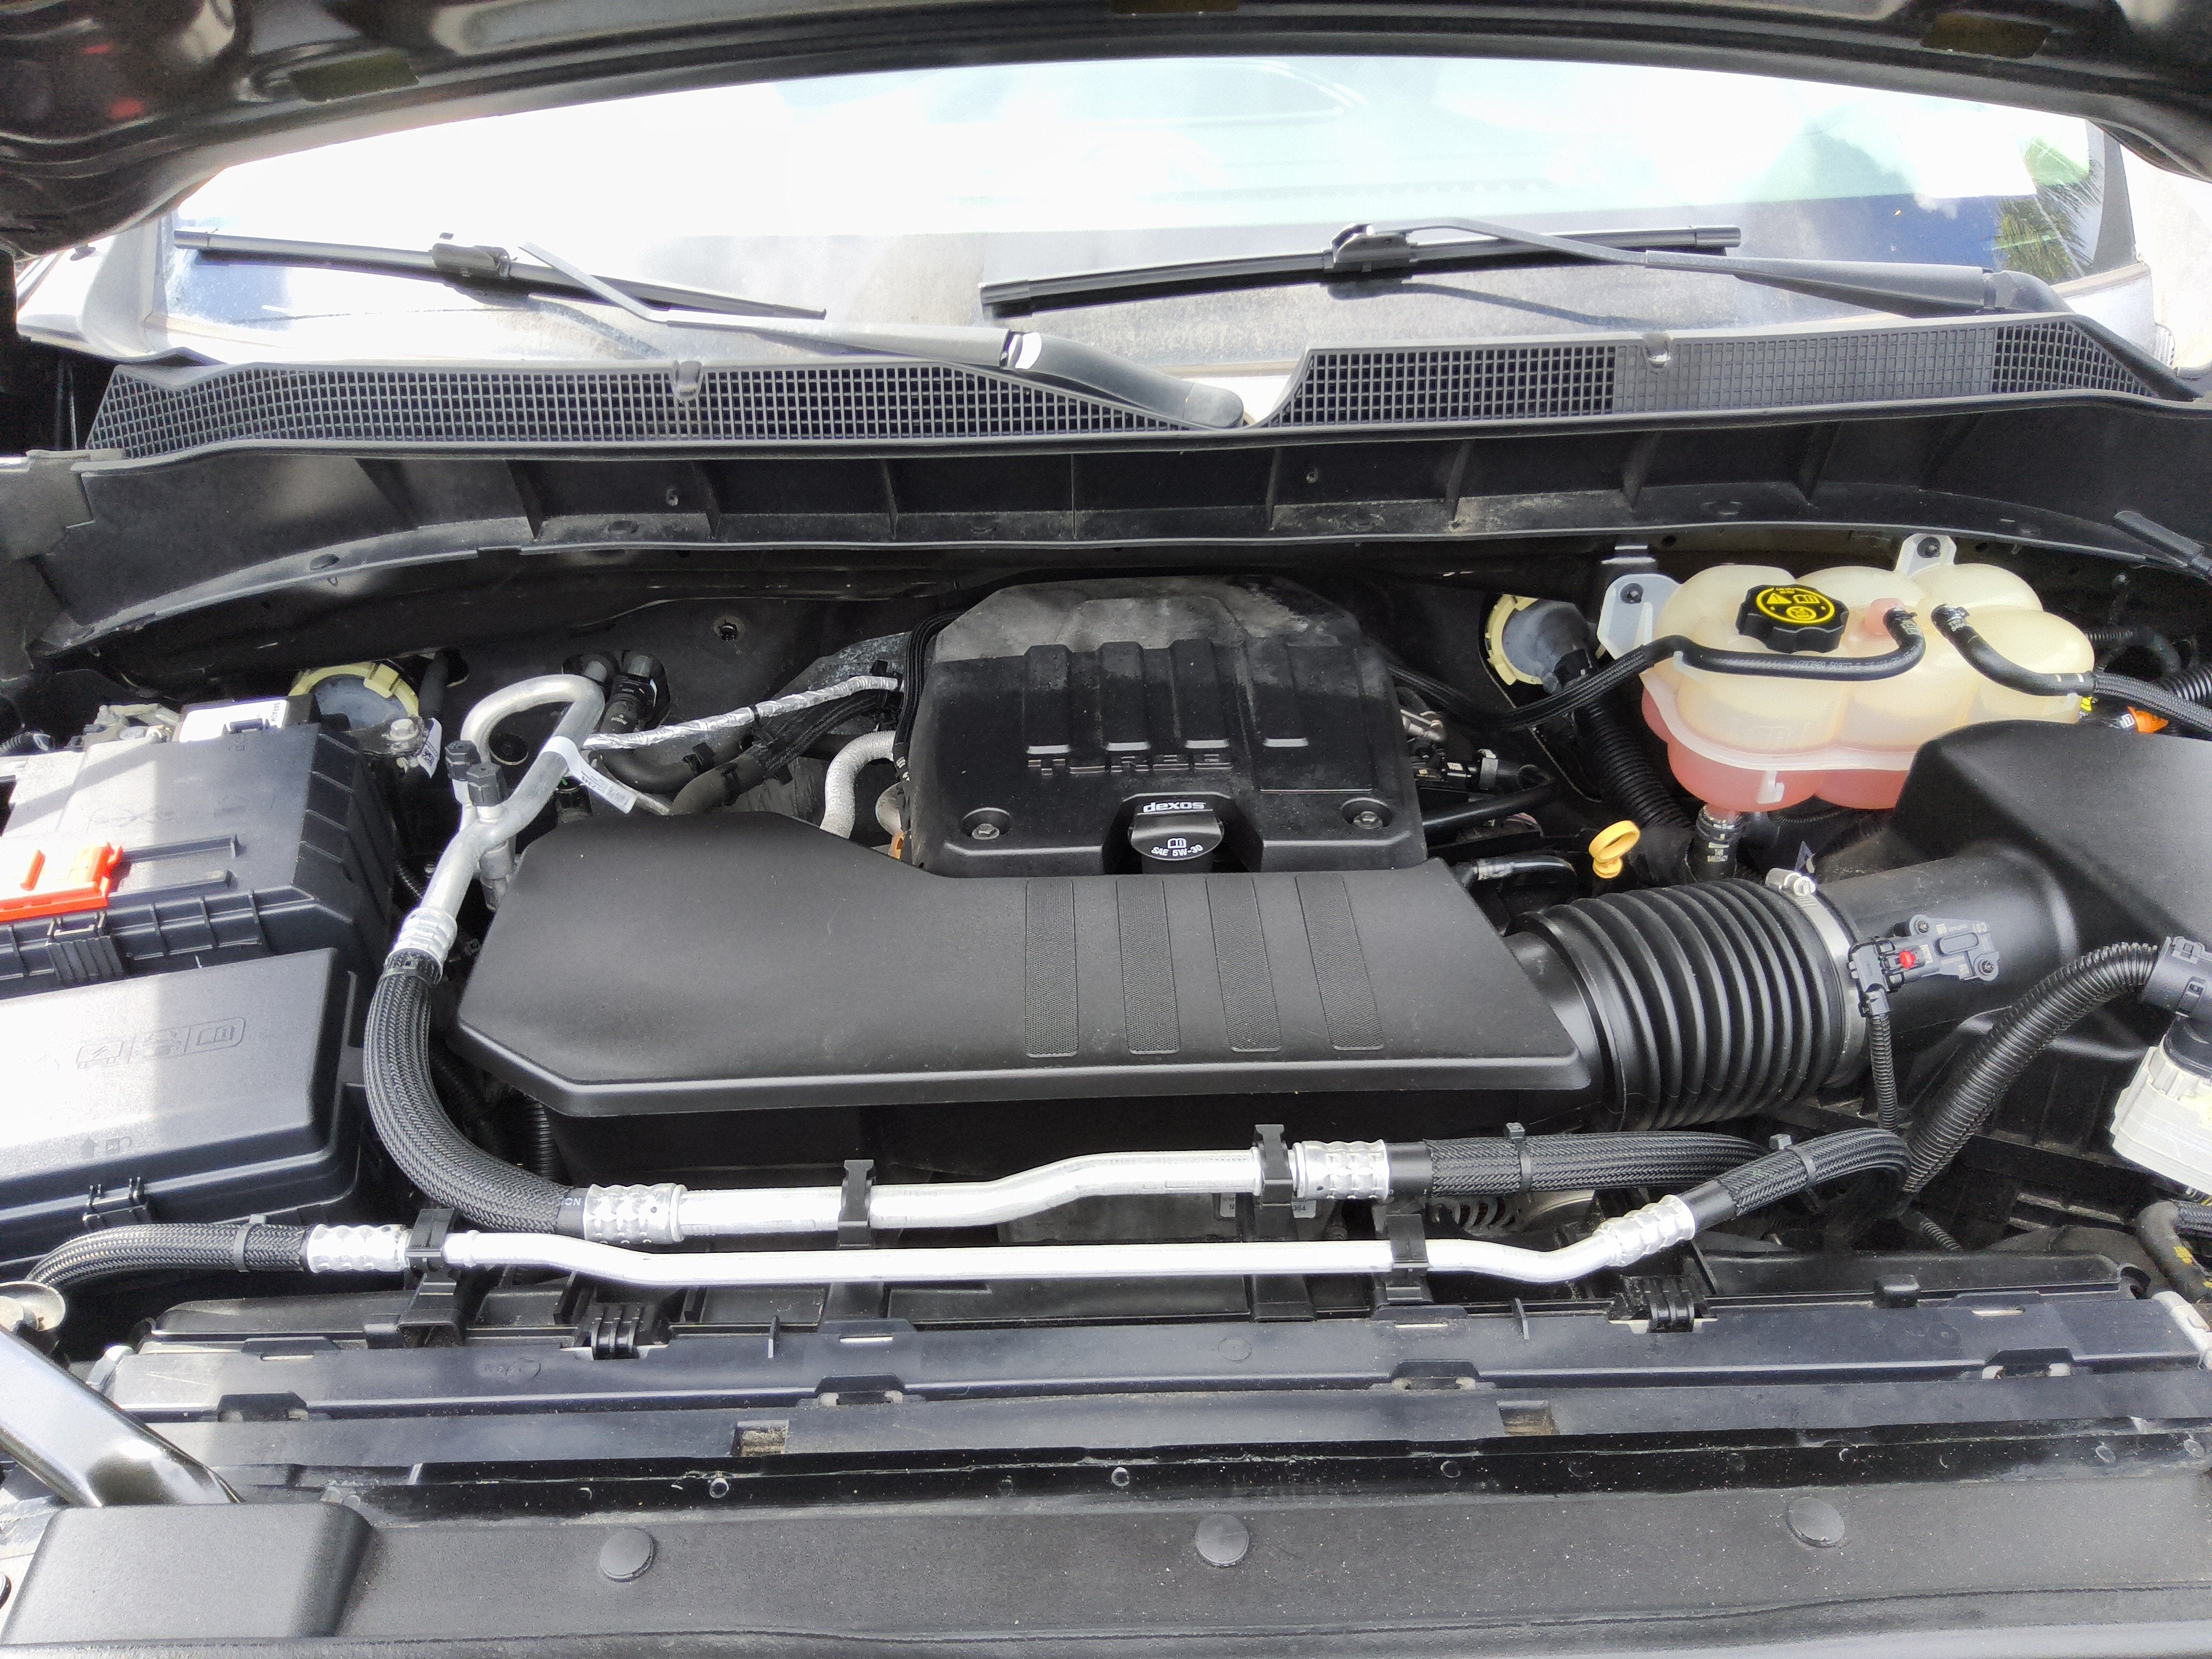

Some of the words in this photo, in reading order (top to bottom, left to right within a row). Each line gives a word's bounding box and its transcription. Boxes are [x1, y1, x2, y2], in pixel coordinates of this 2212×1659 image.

[1142, 802, 1206, 813] dexos
[1151, 846, 1169, 856] SAE
[1172, 844, 1204, 856] 5W-30
